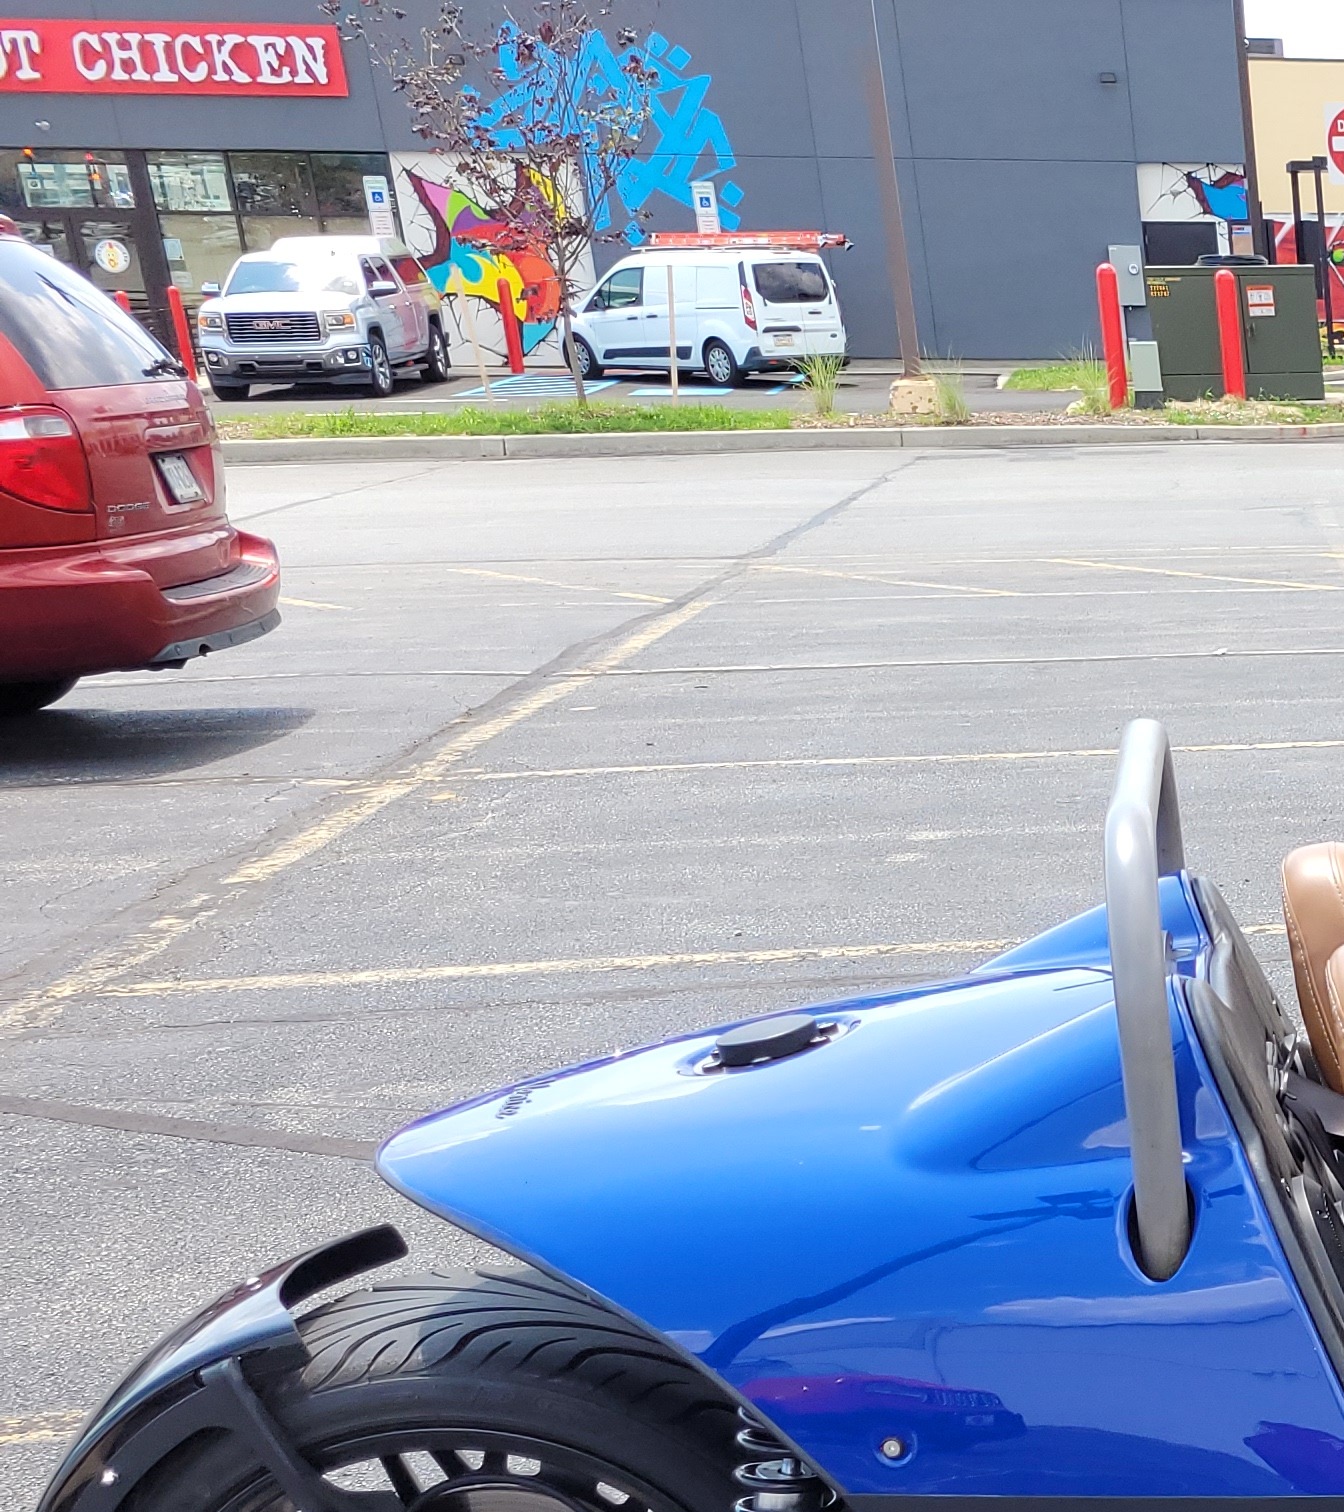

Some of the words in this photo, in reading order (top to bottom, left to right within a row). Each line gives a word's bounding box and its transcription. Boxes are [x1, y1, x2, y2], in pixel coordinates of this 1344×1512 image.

[0, 29, 42, 80] T
[72, 31, 329, 85] CHICKEN
[252, 318, 292, 330] GMC
